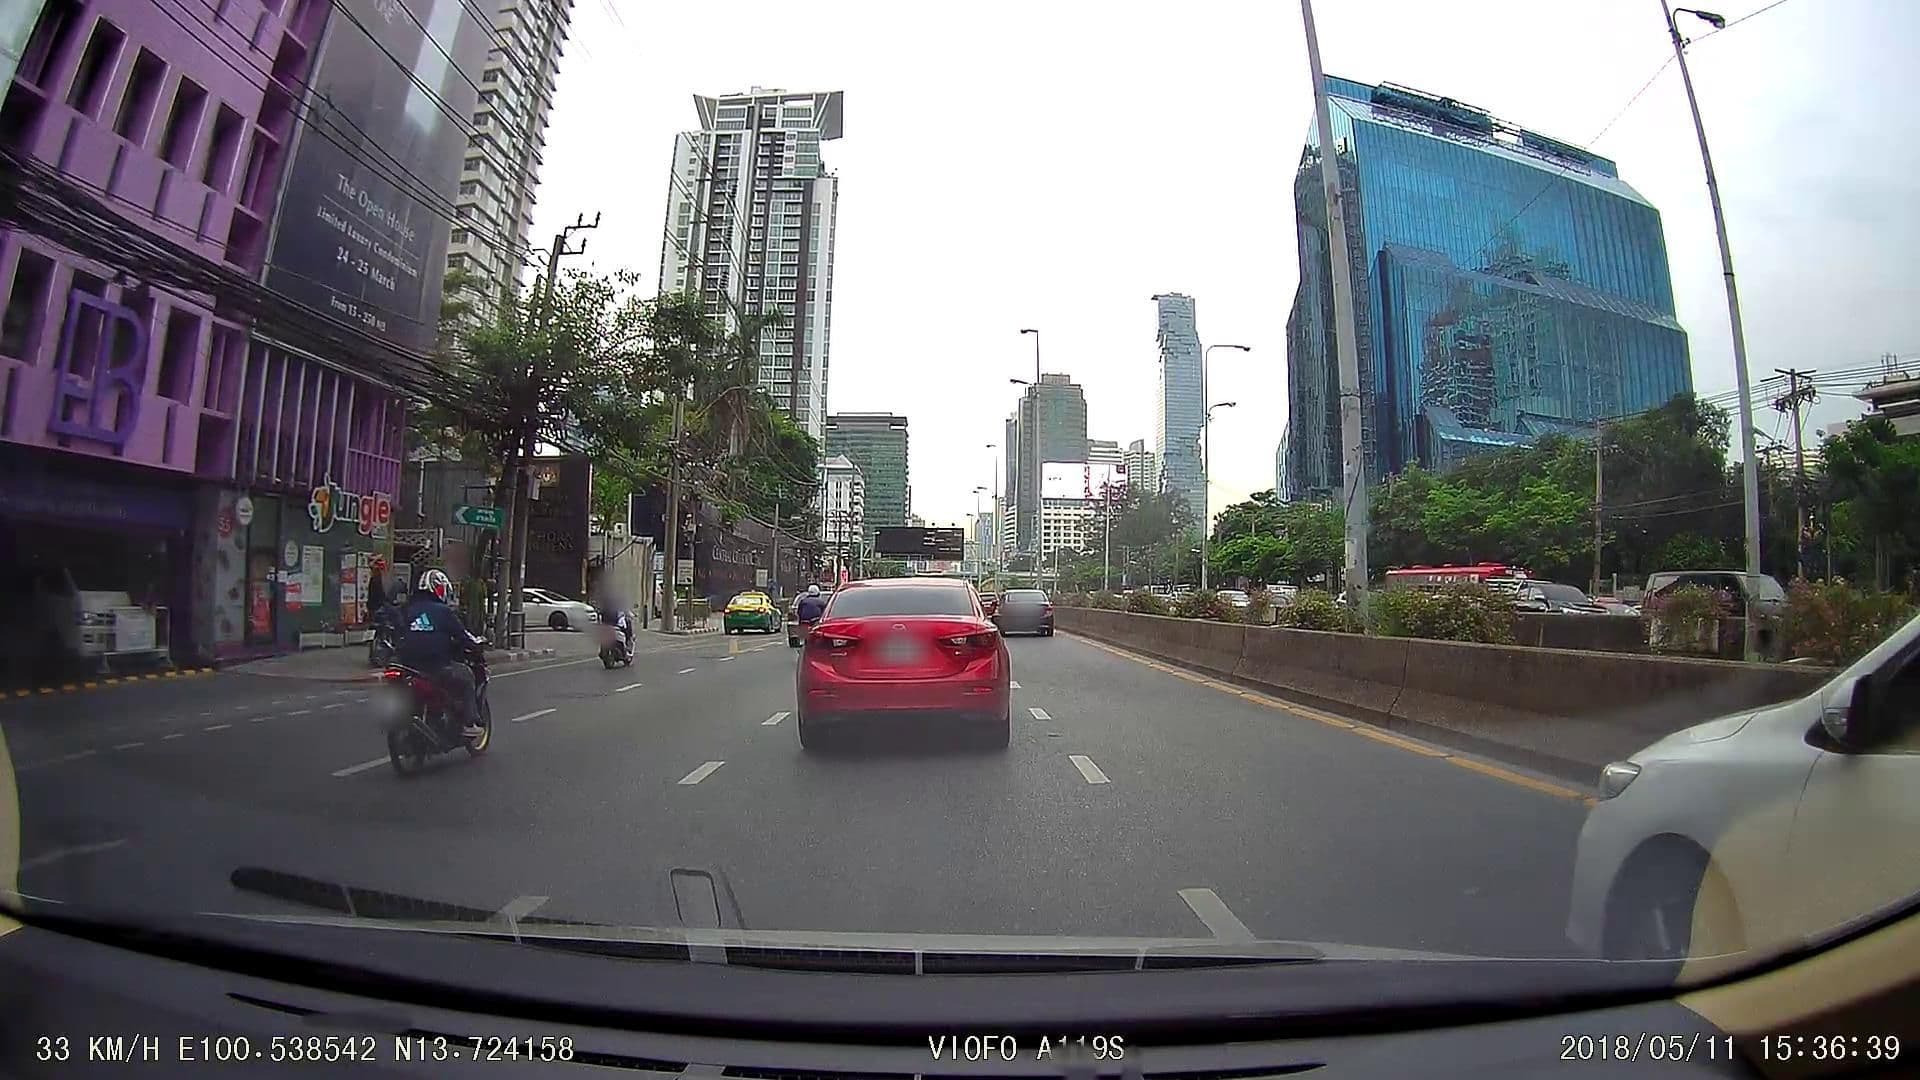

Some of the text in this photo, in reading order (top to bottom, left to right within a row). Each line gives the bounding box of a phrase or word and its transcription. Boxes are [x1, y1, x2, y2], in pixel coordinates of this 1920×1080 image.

[316, 206, 347, 233] Limited
[337, 173, 415, 242] The Open House
[336, 246, 349, 264] 24
[369, 267, 396, 291] March
